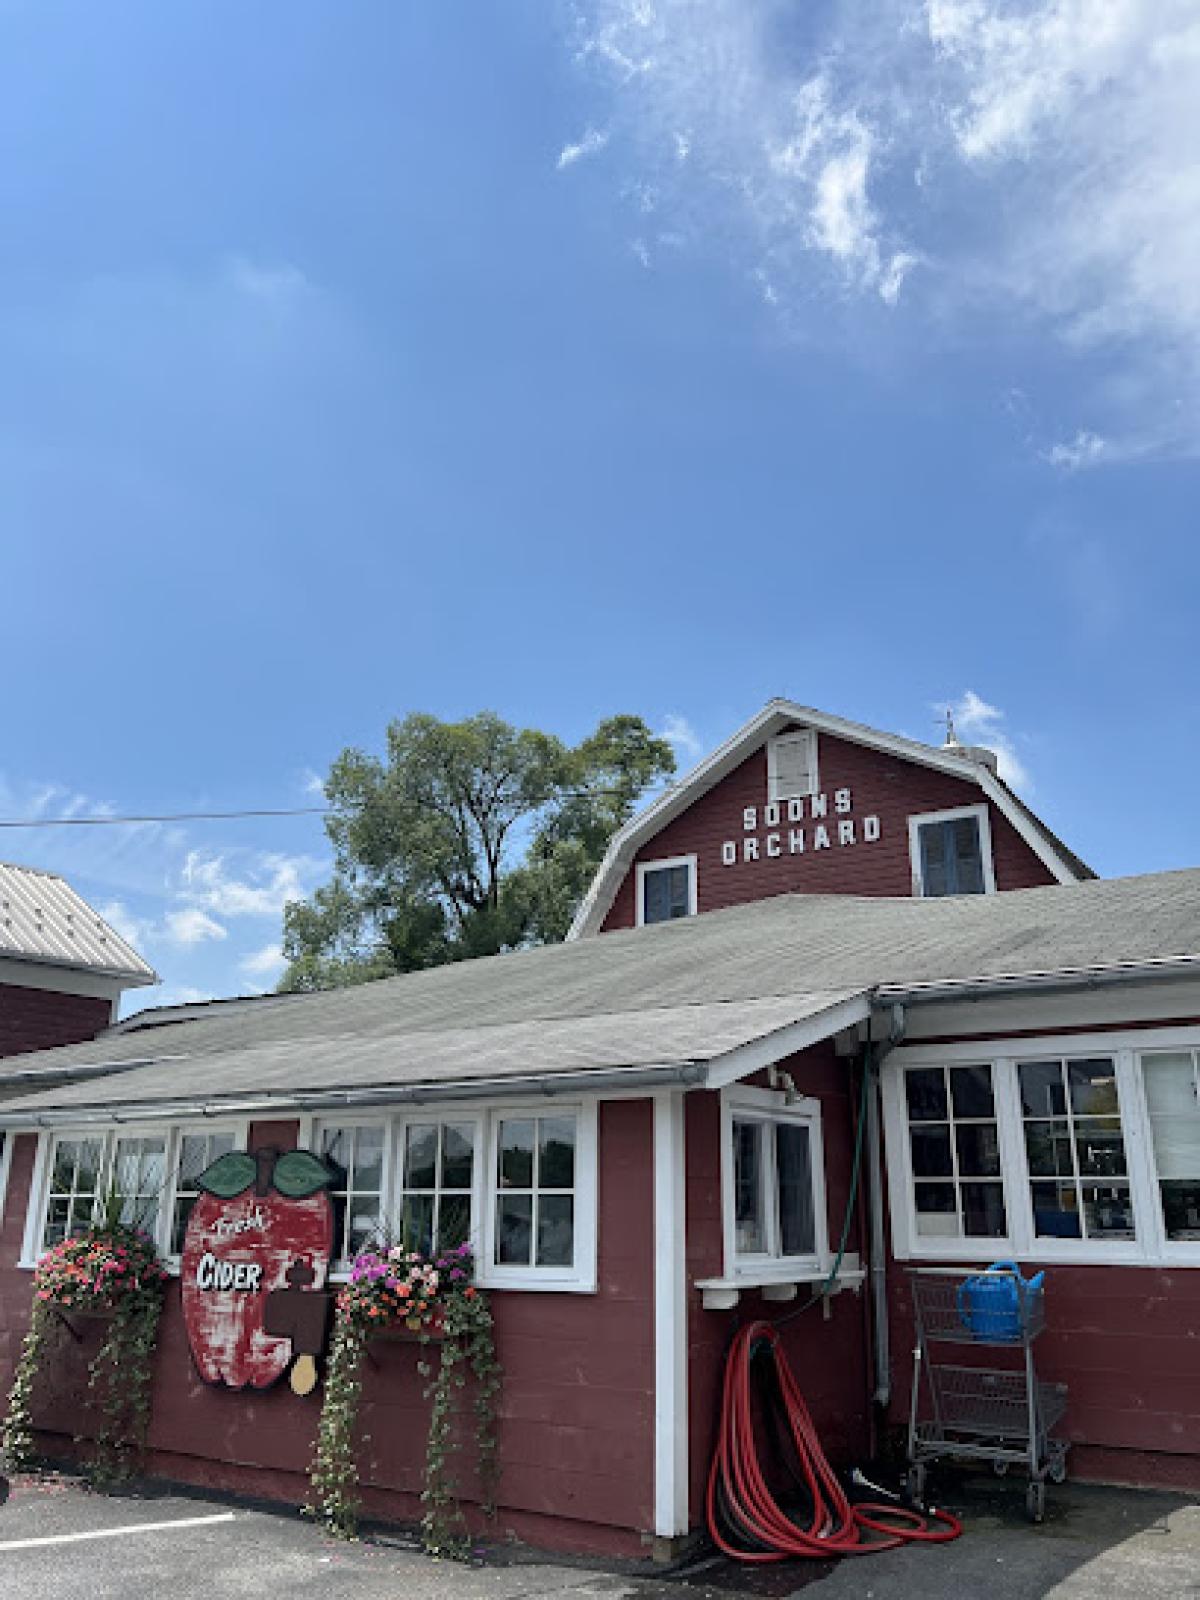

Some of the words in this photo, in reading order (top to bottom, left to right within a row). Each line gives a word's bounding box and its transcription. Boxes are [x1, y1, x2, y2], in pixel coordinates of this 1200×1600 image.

[743, 788, 851, 831] SOONS
[722, 815, 881, 866] ORCHARD
[197, 1252, 262, 1291] CIDER
